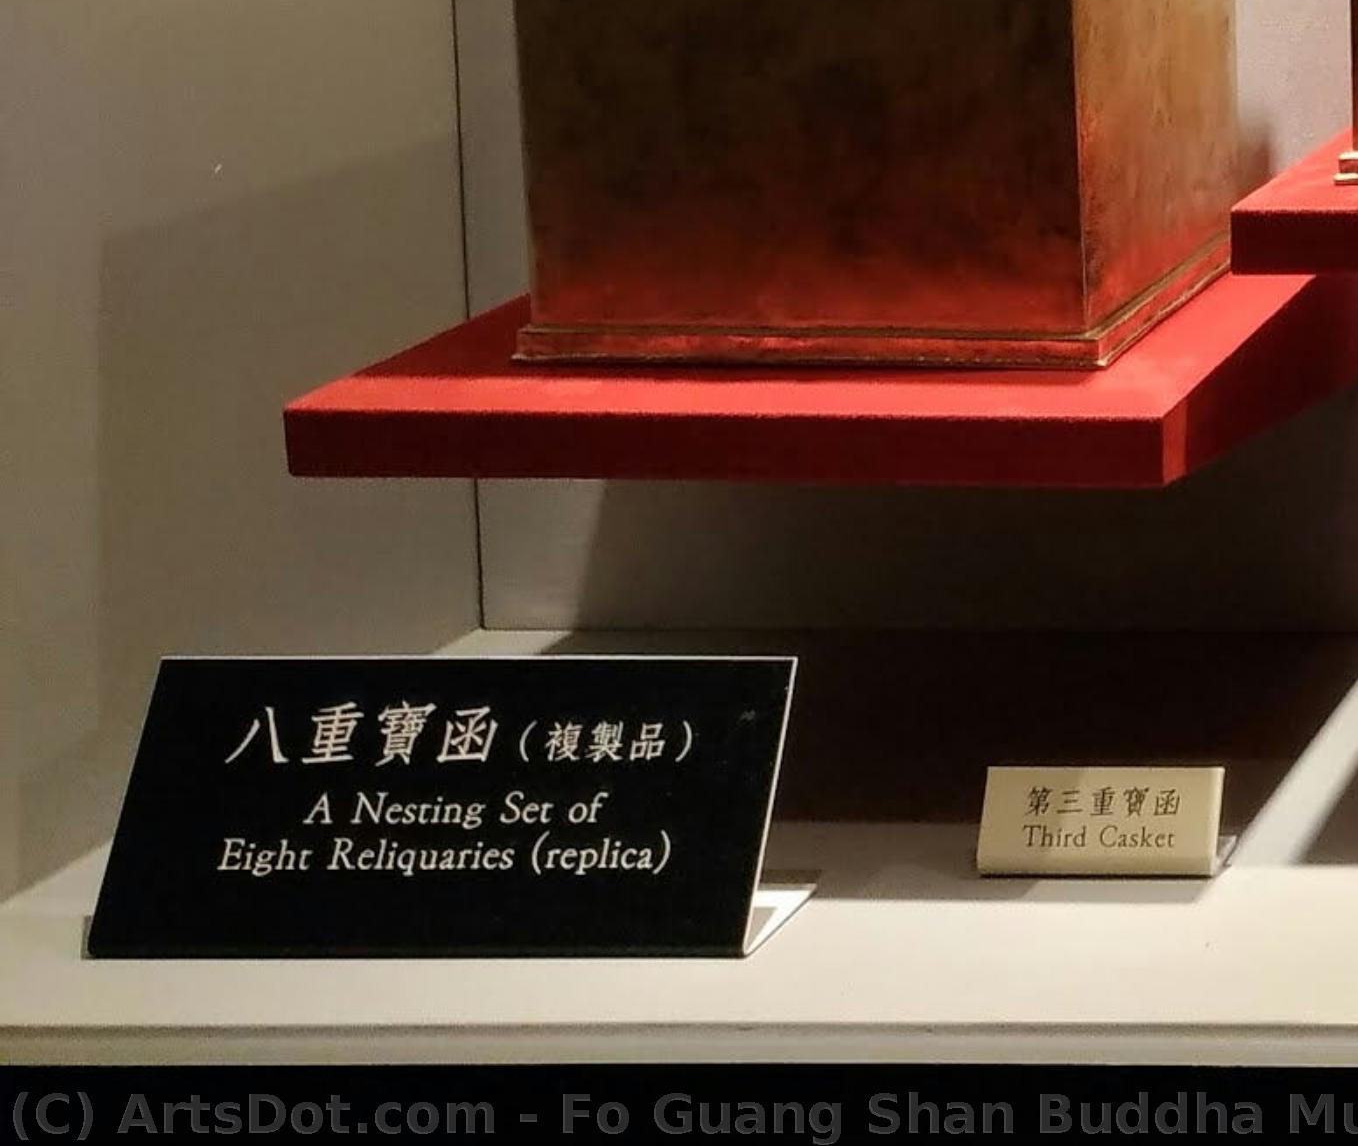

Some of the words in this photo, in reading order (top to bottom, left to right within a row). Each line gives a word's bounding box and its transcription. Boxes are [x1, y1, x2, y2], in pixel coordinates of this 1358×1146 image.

[302, 792, 334, 824] A
[350, 791, 486, 827] Nesting
[499, 790, 554, 824] Set
[568, 791, 610, 824] of
[1023, 785, 1181, 817] 第三重寶函
[1021, 824, 1087, 848] Third
[1098, 824, 1176, 849] Casket
[216, 838, 313, 877] Eight
[326, 837, 515, 877] Reliquaries
[530, 830, 672, 878] (replica)
